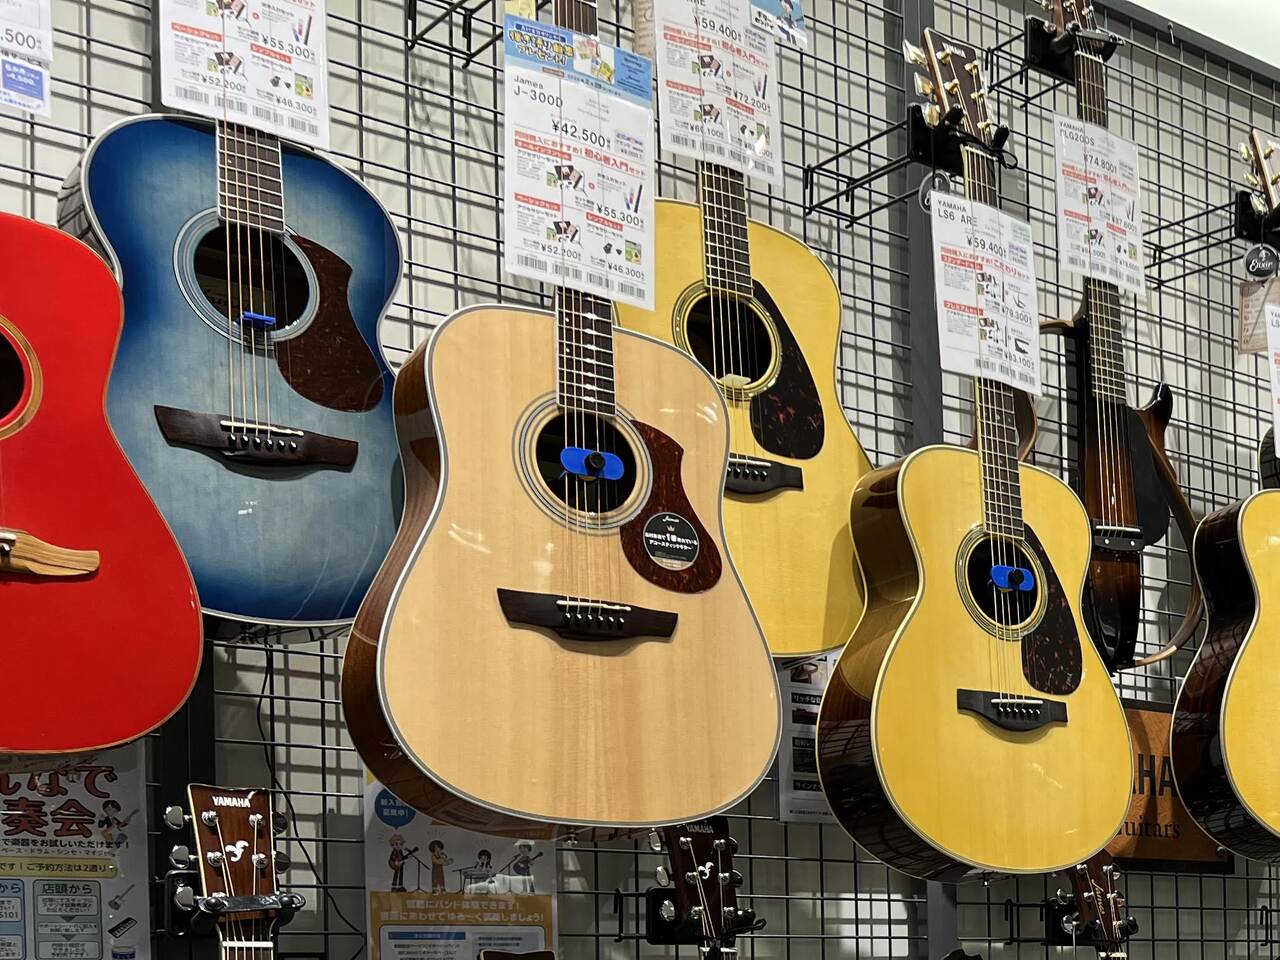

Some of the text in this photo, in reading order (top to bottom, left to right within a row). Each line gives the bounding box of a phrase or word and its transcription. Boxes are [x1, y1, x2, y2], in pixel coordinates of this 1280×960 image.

[514, 75, 543, 89] James
[514, 86, 563, 108] J-300D
[937, 200, 967, 212] YAMAHA
[938, 209, 955, 220] LS6
[213, 796, 250, 808] YAMAHA
[42, 884, 92, 894] 店頭から
